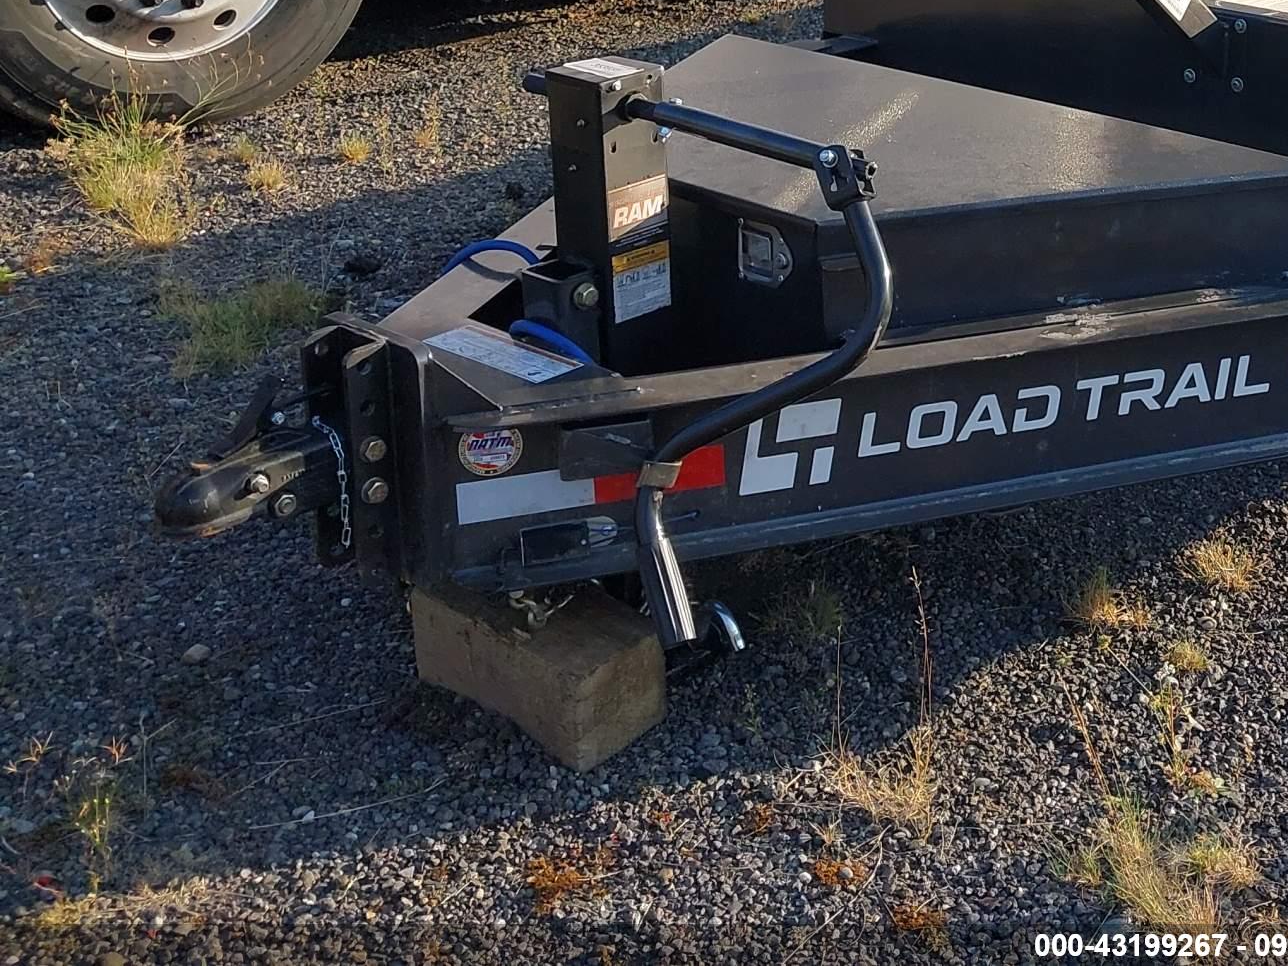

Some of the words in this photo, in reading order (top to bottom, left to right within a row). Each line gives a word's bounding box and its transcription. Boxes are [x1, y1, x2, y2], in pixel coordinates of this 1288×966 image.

[613, 194, 664, 228] RAM
[857, 385, 1061, 458] LOAD
[1076, 355, 1270, 421] TRAIL
